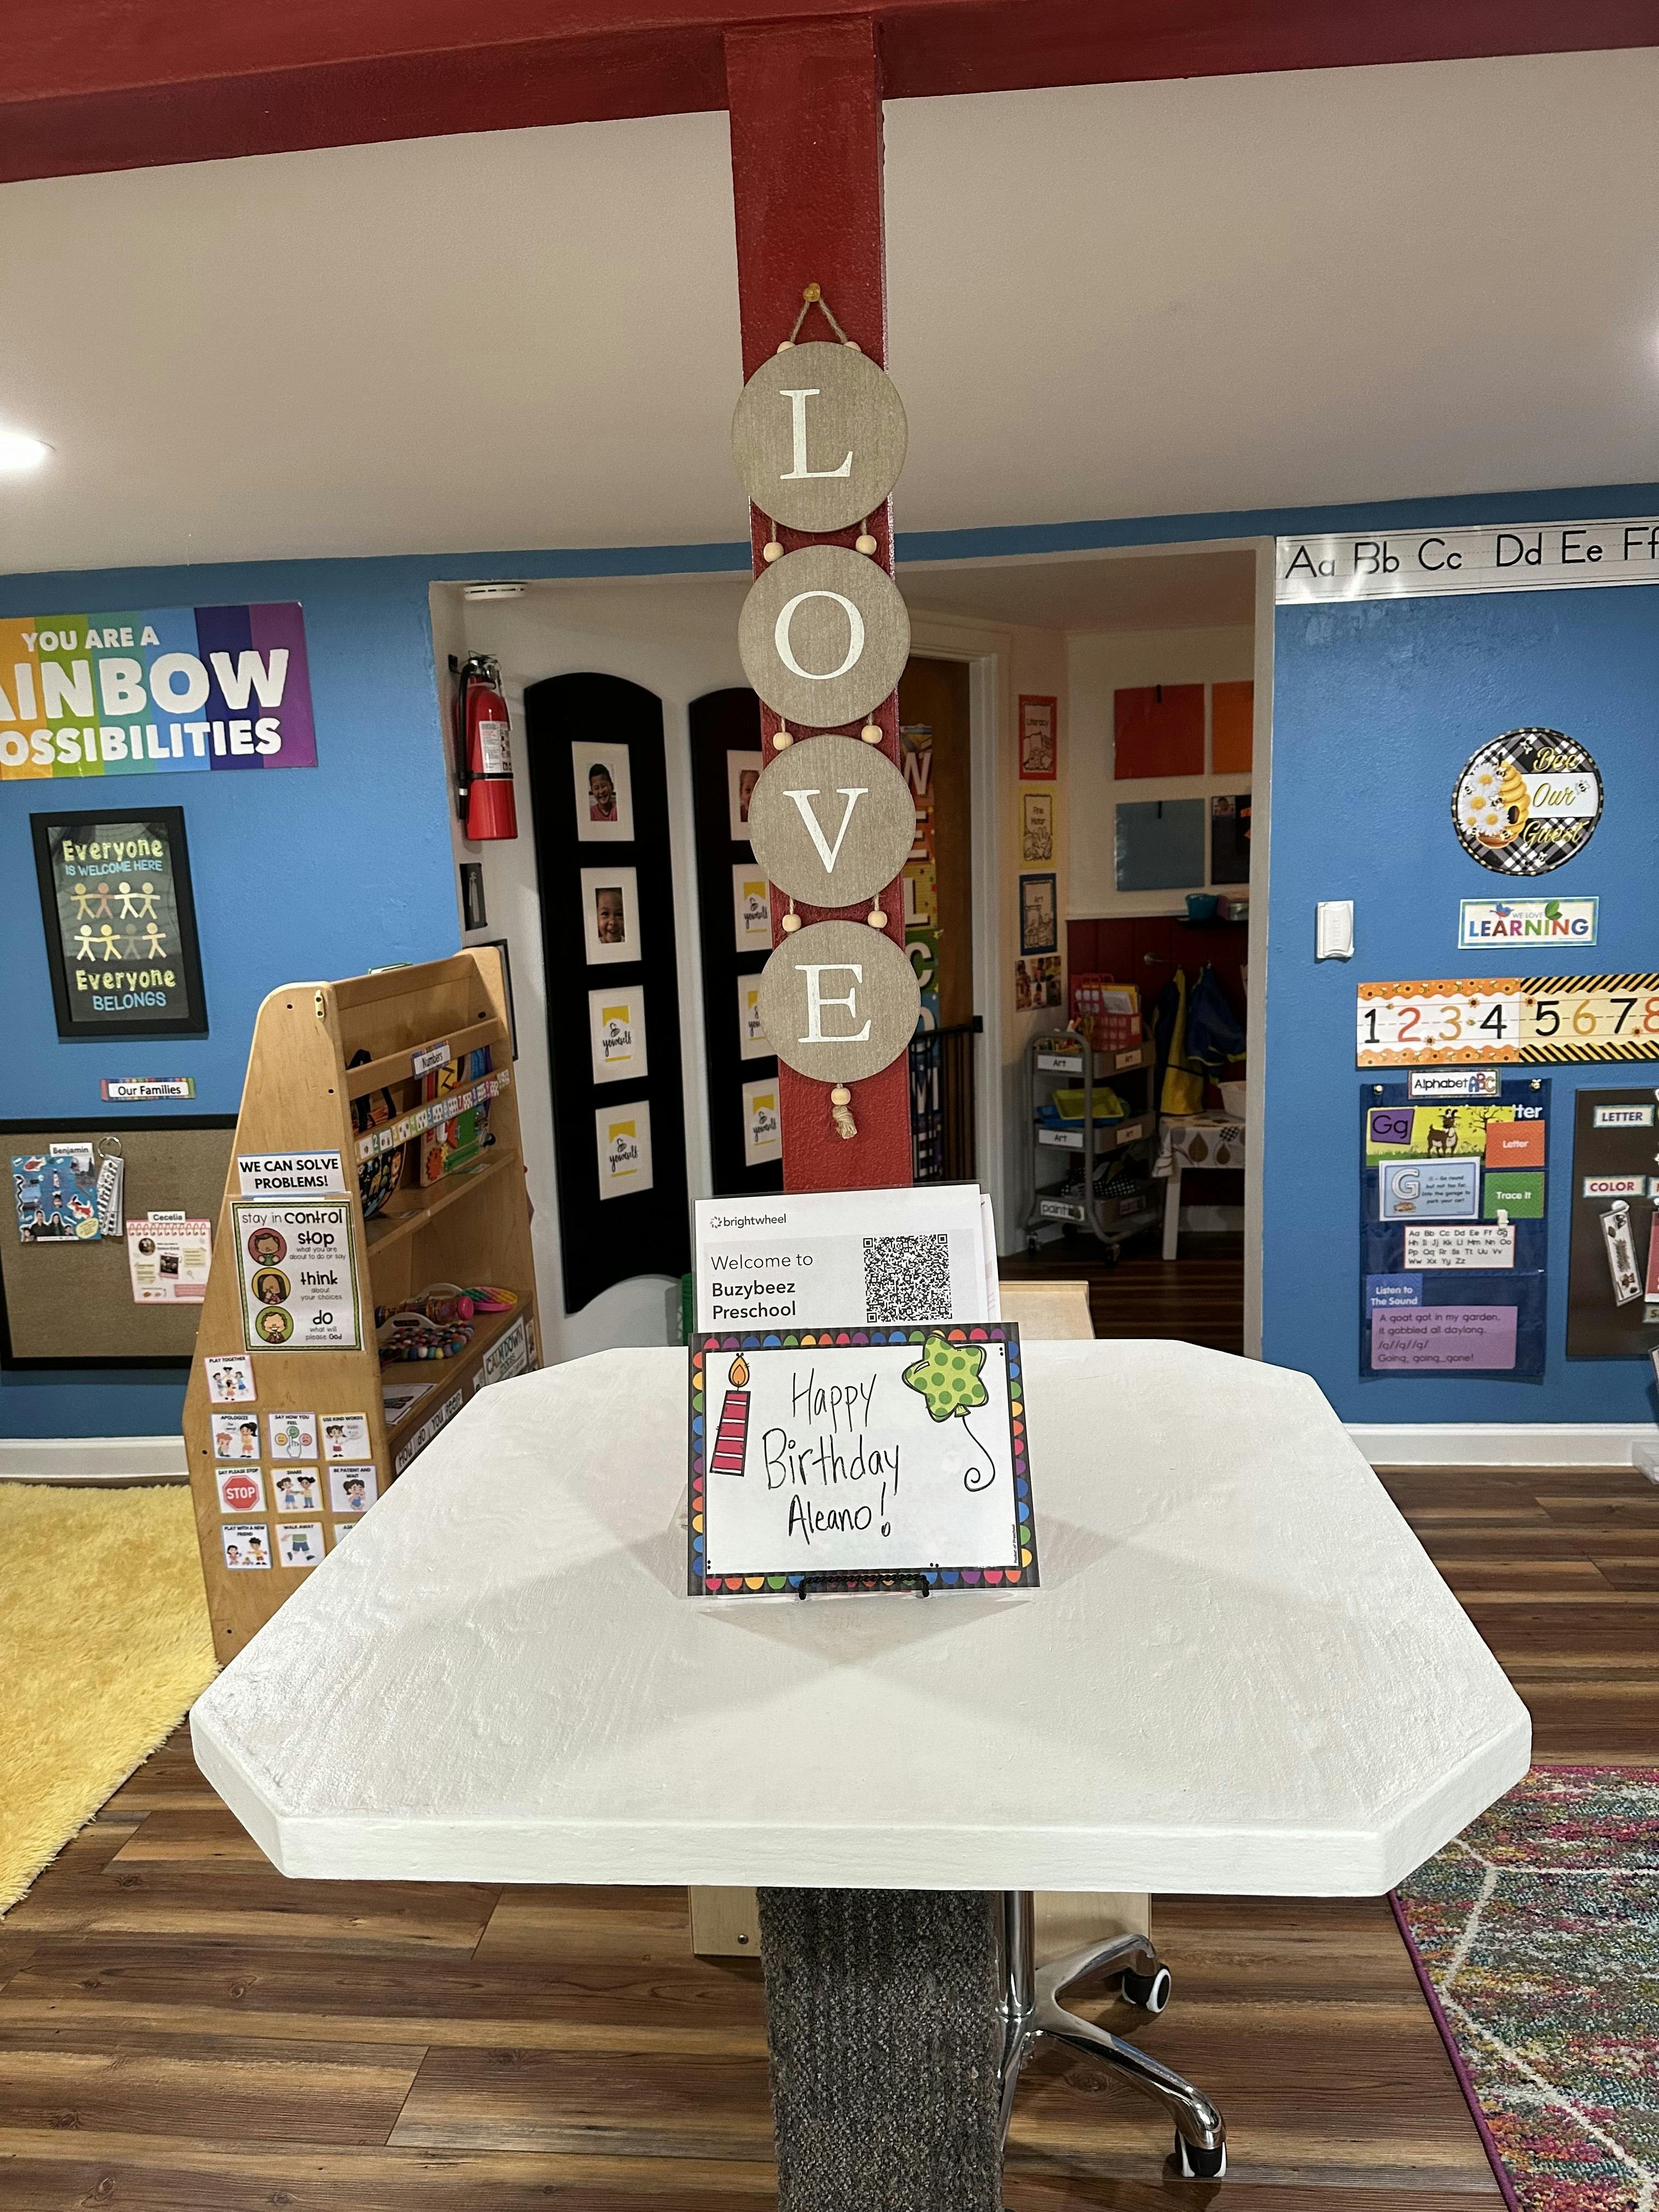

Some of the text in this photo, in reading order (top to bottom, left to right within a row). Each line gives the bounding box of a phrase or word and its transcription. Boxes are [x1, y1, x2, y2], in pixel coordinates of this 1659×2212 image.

[1285, 526, 1659, 578] Aa Bb Cc Dd Ee Ff
[21, 626, 160, 652] YOU ARE A
[0, 718, 281, 765] OSSIBILITIES
[1533, 747, 1580, 771] Bee
[1533, 783, 1576, 807] Our
[1523, 821, 1590, 848] Guest
[63, 839, 163, 861] Everyone
[66, 860, 162, 875] IS WELCOME HERE
[1469, 918, 1589, 937] LEARNING
[76, 969, 176, 990] Everyone
[93, 991, 166, 1011] BELONGS
[1364, 997, 1659, 1043] 1 2 3 4 5 6 7 8
[422, 1052, 443, 1068] Numbers
[118, 1085, 181, 1096] Our Families
[1414, 1071, 1496, 1092] Alphabet ABC
[1602, 1112, 1643, 1121] LETTER
[1372, 1115, 1408, 1139] Gg
[240, 1158, 338, 1172] WE CAN SOLVE
[255, 1176, 328, 1189] PROBLEMS!
[1392, 1169, 1420, 1199] G
[1590, 1182, 1634, 1192] COLOR
[1496, 1192, 1521, 1200] Trace
[242, 1209, 343, 1226] stay in control
[723, 1214, 786, 1229] brightwheel
[297, 1231, 335, 1247] stop
[711, 1253, 813, 1271] Welcome to
[301, 1270, 338, 1285] think
[712, 1280, 795, 1300] Buzybeez
[1376, 1286, 1413, 1295] Listen to
[713, 1301, 796, 1319] Preschool
[1389, 1297, 1418, 1305] Sound
[313, 1310, 333, 1324] do
[1389, 1314, 1413, 1323] goat
[1415, 1313, 1431, 1323] got
[1446, 1314, 1459, 1323] my
[1387, 1327, 1427, 1336] gobbled
[792, 1368, 877, 1433] Happy
[763, 1428, 899, 1496] Birthday
[226, 1487, 256, 1499] STOP
